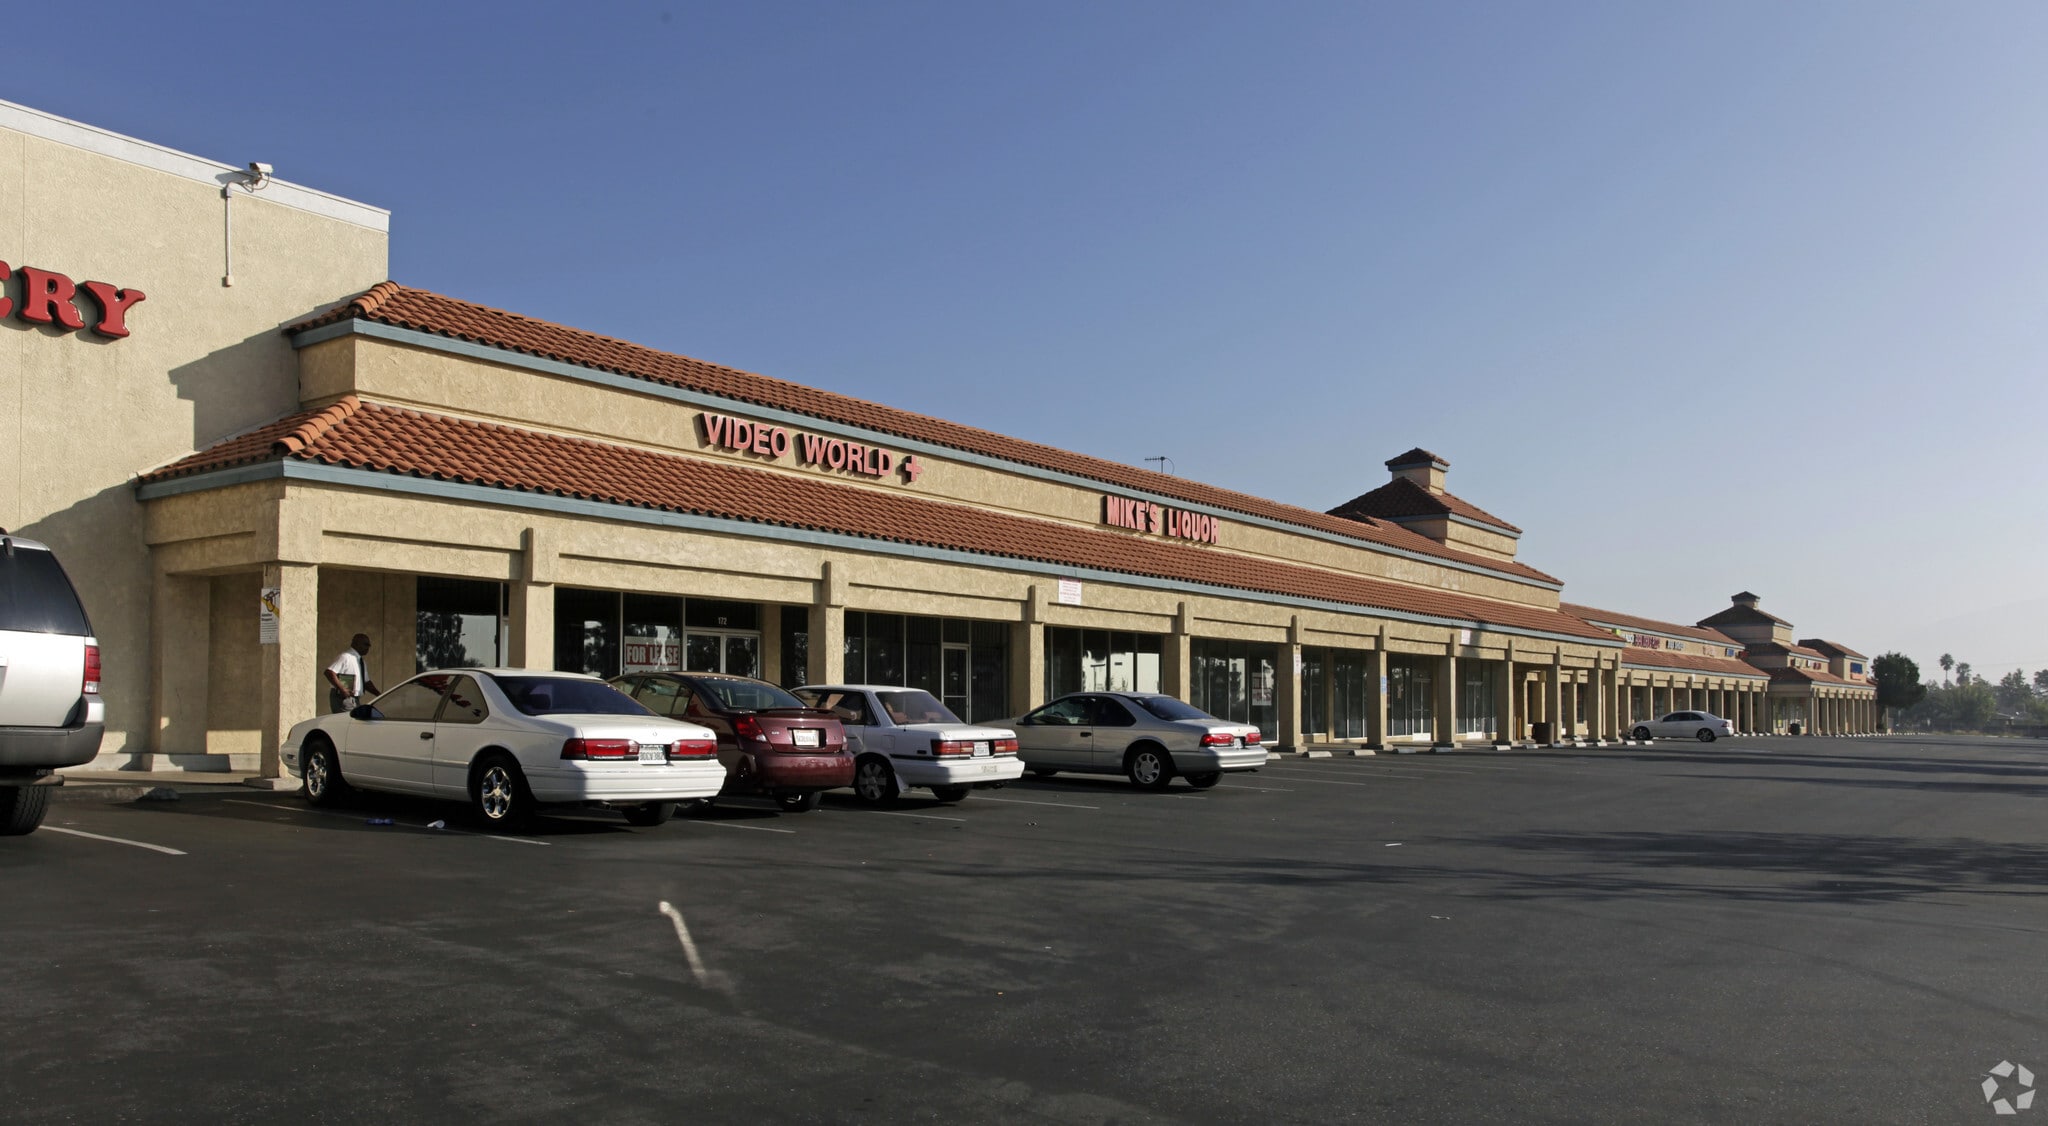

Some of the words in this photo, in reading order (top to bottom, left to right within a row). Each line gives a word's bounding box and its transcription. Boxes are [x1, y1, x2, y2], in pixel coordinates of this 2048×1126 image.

[703, 412, 791, 457] VIDEO
[803, 433, 893, 476] WORLD
[1106, 495, 1159, 533] MIKE'S
[1167, 507, 1219, 544] LIQUOR
[626, 645, 647, 664] FOR
[650, 646, 678, 664] LEASE
